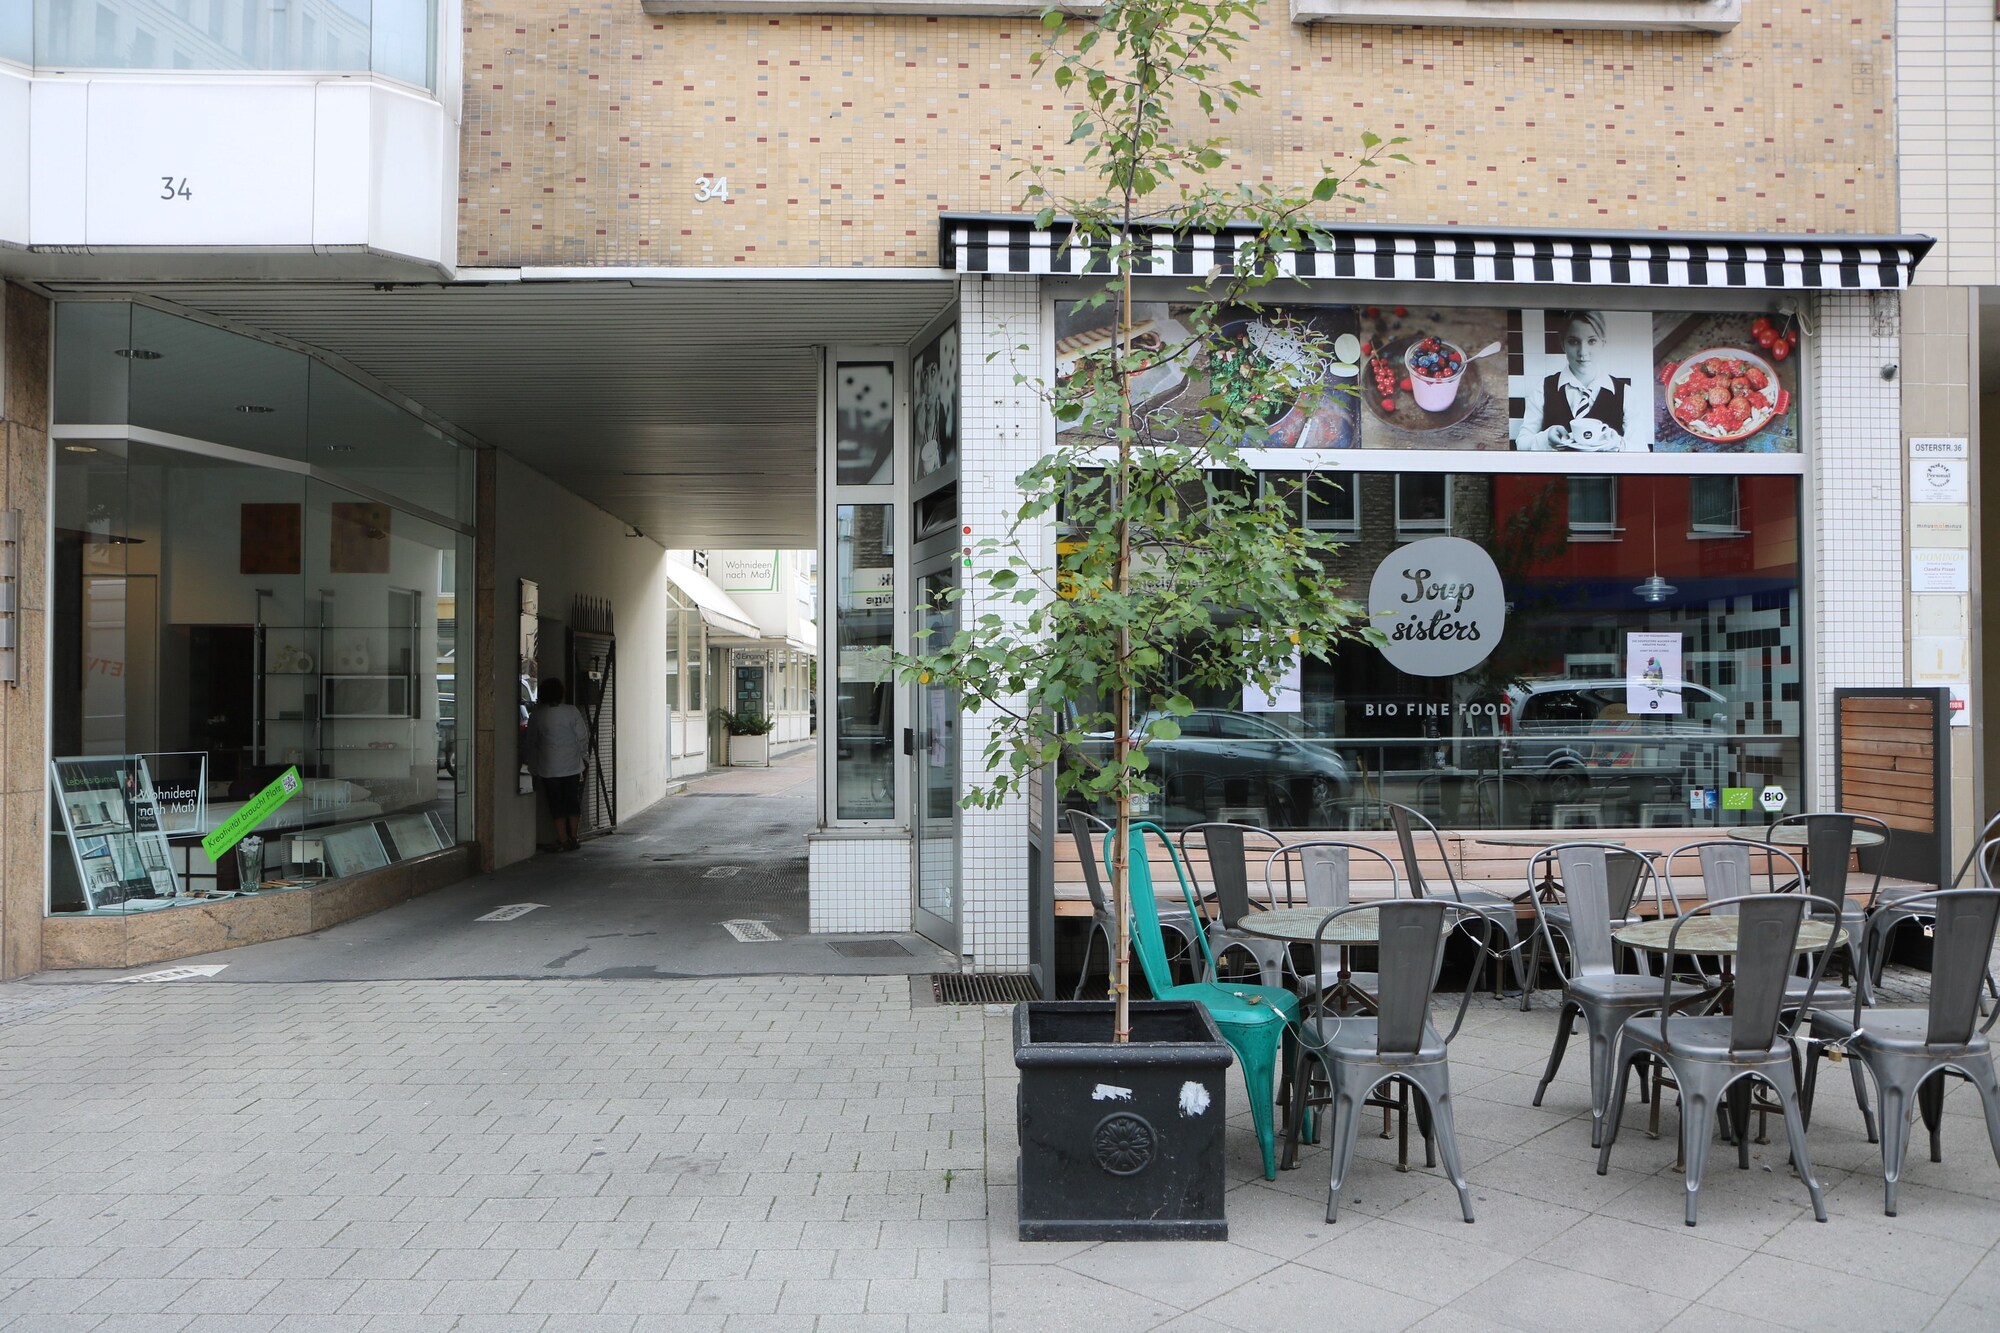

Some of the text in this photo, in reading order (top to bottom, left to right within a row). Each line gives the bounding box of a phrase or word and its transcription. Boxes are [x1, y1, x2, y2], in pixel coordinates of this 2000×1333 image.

[160, 176, 193, 201] 34
[694, 176, 729, 202] 34
[1915, 443, 1962, 452] OSTERSTR. 36
[1919, 553, 1960, 561] DOMINO
[725, 560, 773, 570] Wohnideen
[725, 569, 771, 579] nach Maß
[1400, 568, 1475, 613] Soup
[1392, 608, 1481, 641] sisters
[1365, 703, 1511, 717] BIO FINE FOOD
[170, 799, 196, 814] Maß
[207, 817, 241, 849] Kreativität
[241, 798, 266, 821] braucht
[265, 785, 282, 800] Platz
